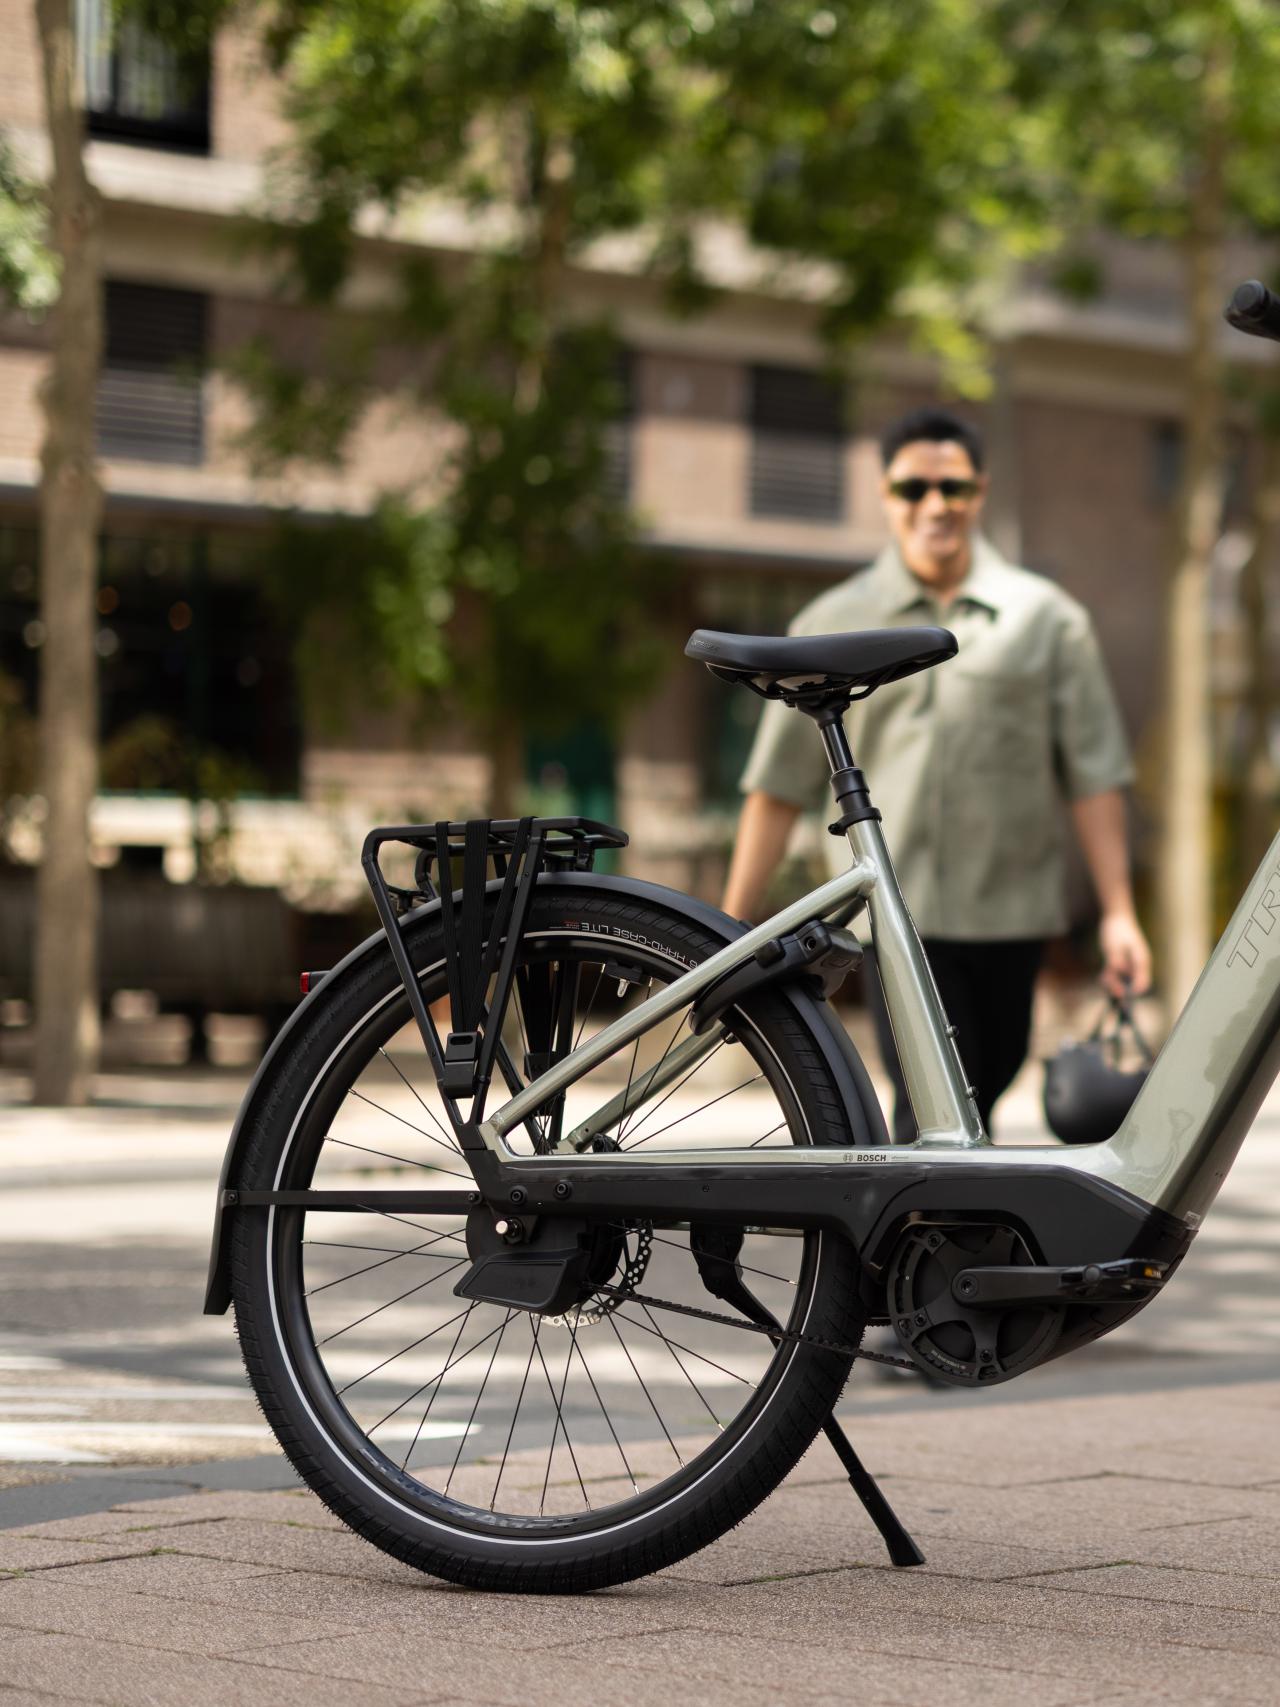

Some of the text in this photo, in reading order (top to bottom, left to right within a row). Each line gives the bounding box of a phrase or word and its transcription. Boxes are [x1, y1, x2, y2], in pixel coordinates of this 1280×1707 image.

[581, 922, 609, 933] LITE
[613, 927, 686, 962] HARD-CASE
[857, 1154, 887, 1162] BOSCH
